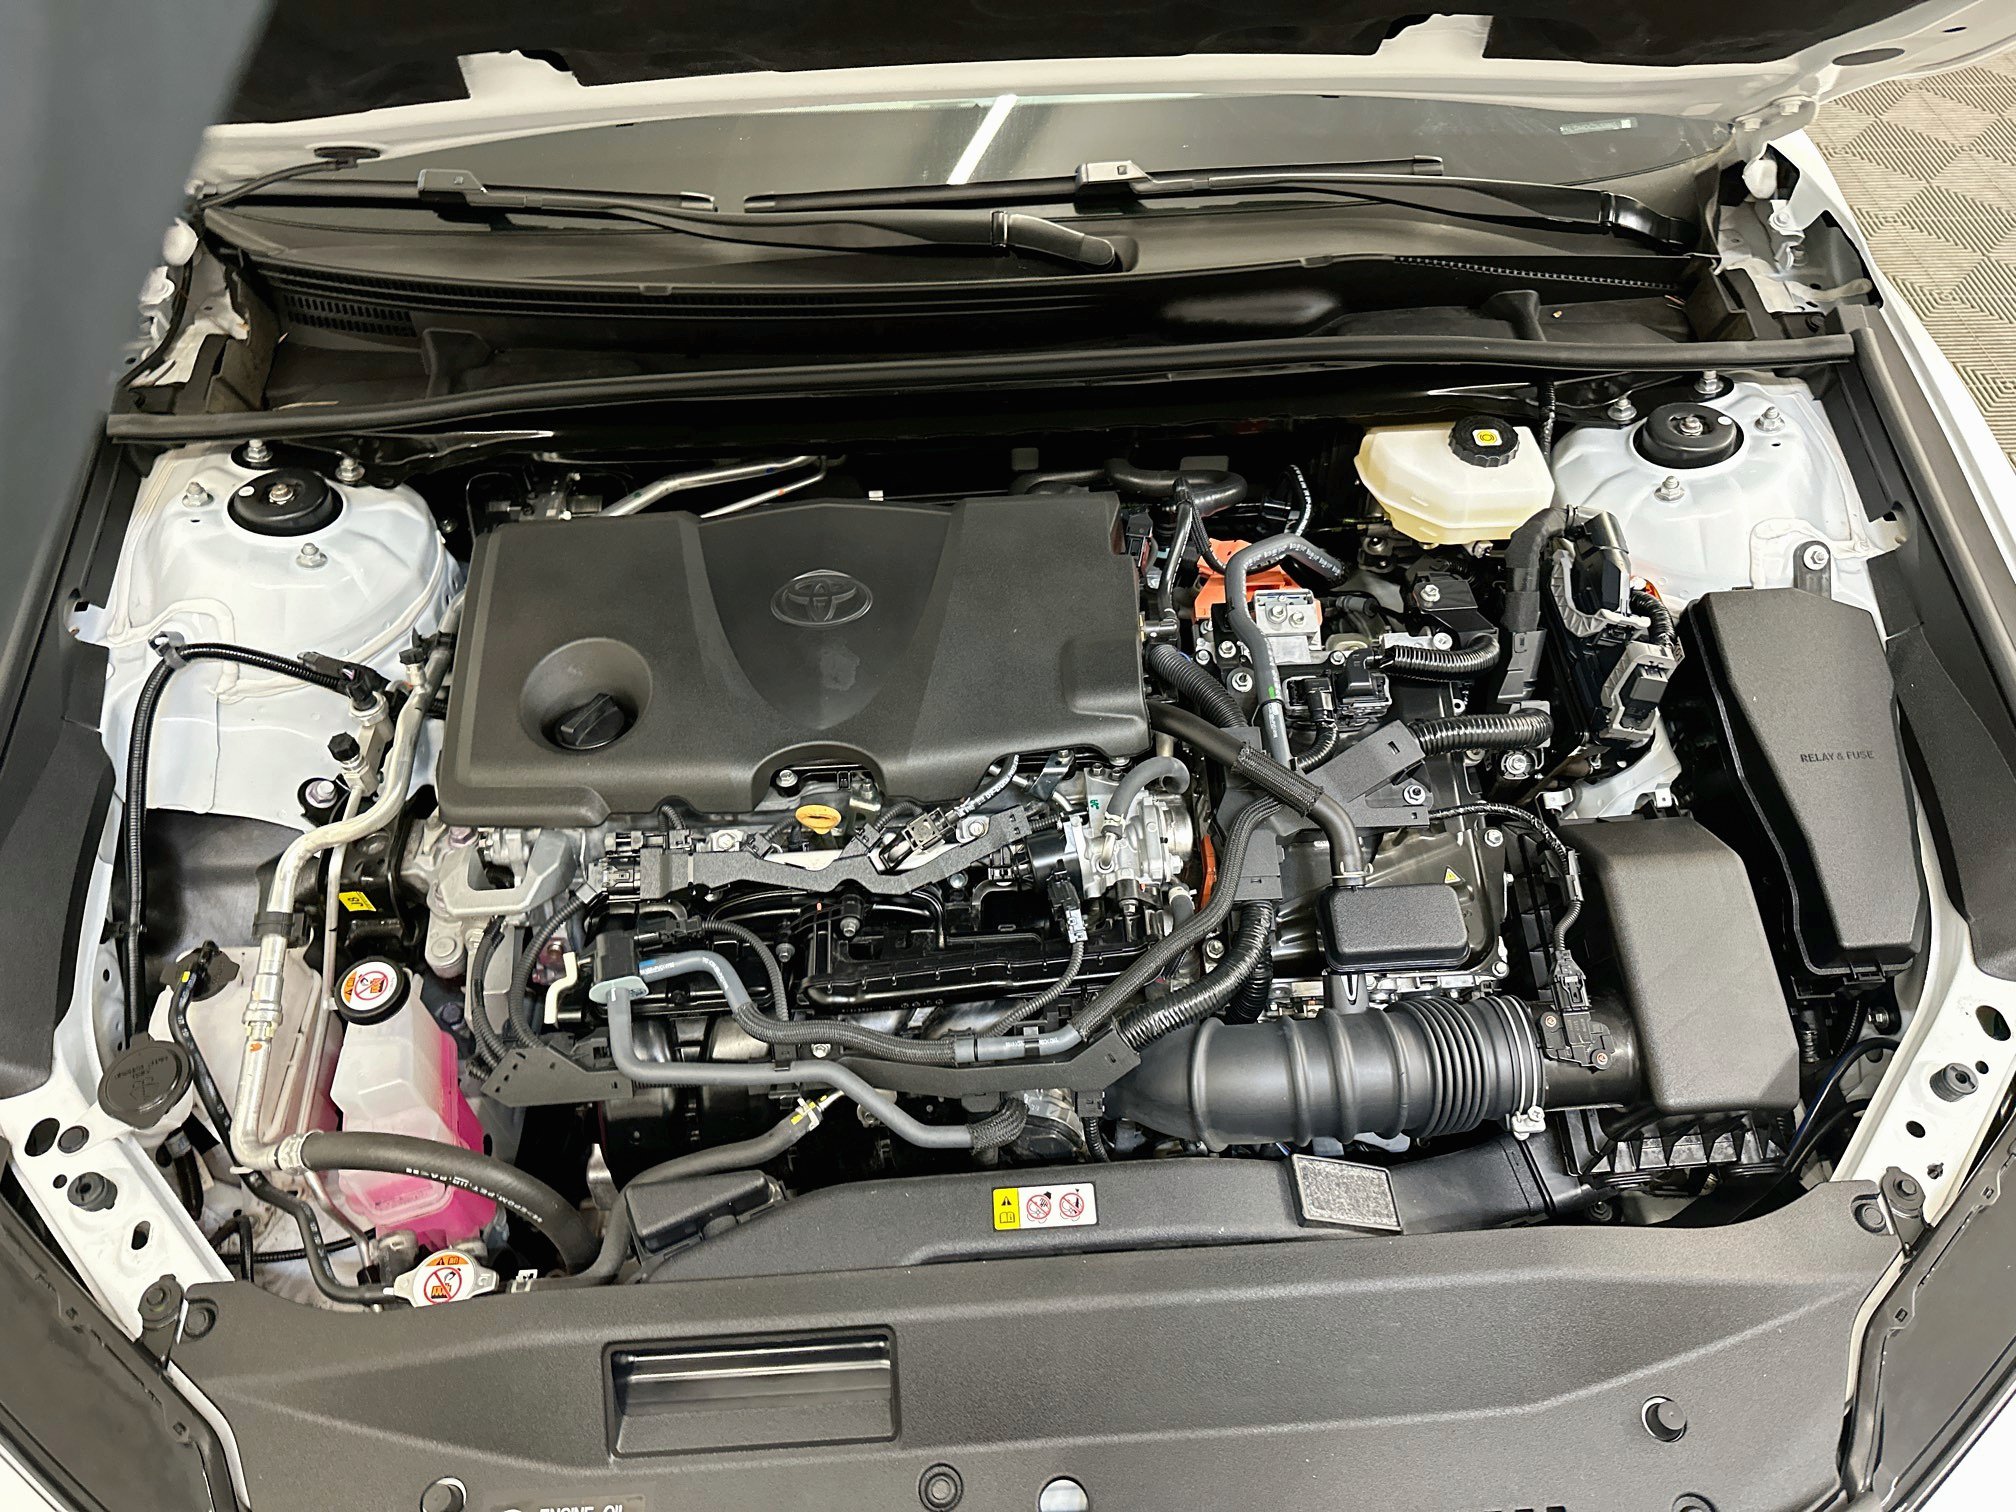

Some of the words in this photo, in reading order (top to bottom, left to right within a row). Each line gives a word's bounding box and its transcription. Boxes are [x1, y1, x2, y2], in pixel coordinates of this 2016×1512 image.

[1800, 752, 1834, 763] RELAY
[1836, 753, 1845, 761] &
[1846, 750, 1874, 760] FUSE
